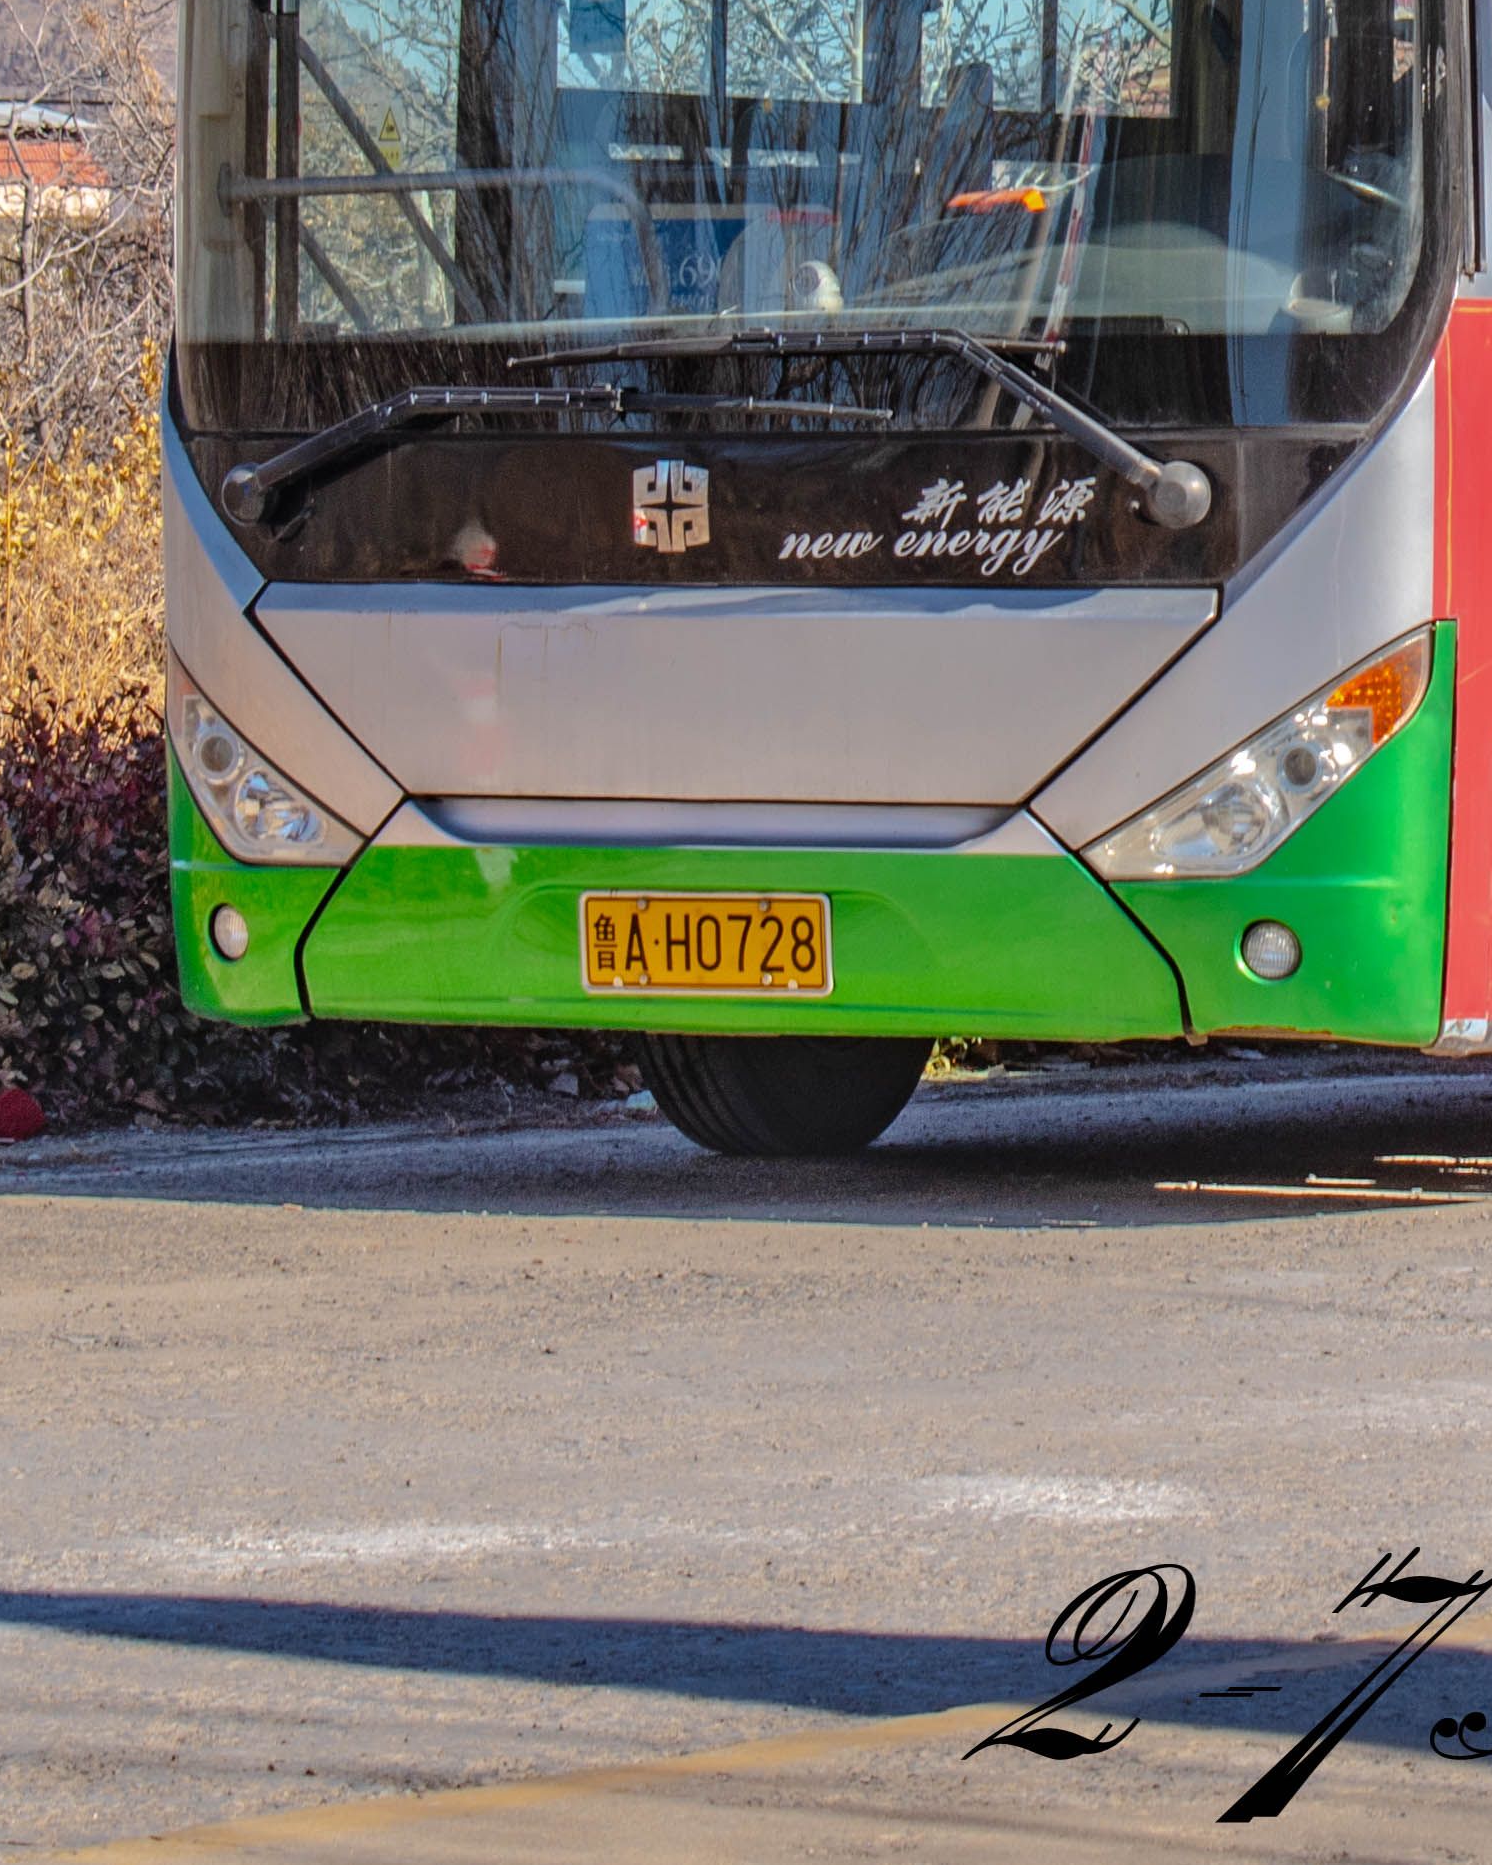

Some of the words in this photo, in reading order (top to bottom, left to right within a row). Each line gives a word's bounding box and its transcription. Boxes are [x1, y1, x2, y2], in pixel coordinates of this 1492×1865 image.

[901, 477, 1097, 530] 新能源
[778, 531, 884, 560] new
[894, 528, 1065, 576] energy
